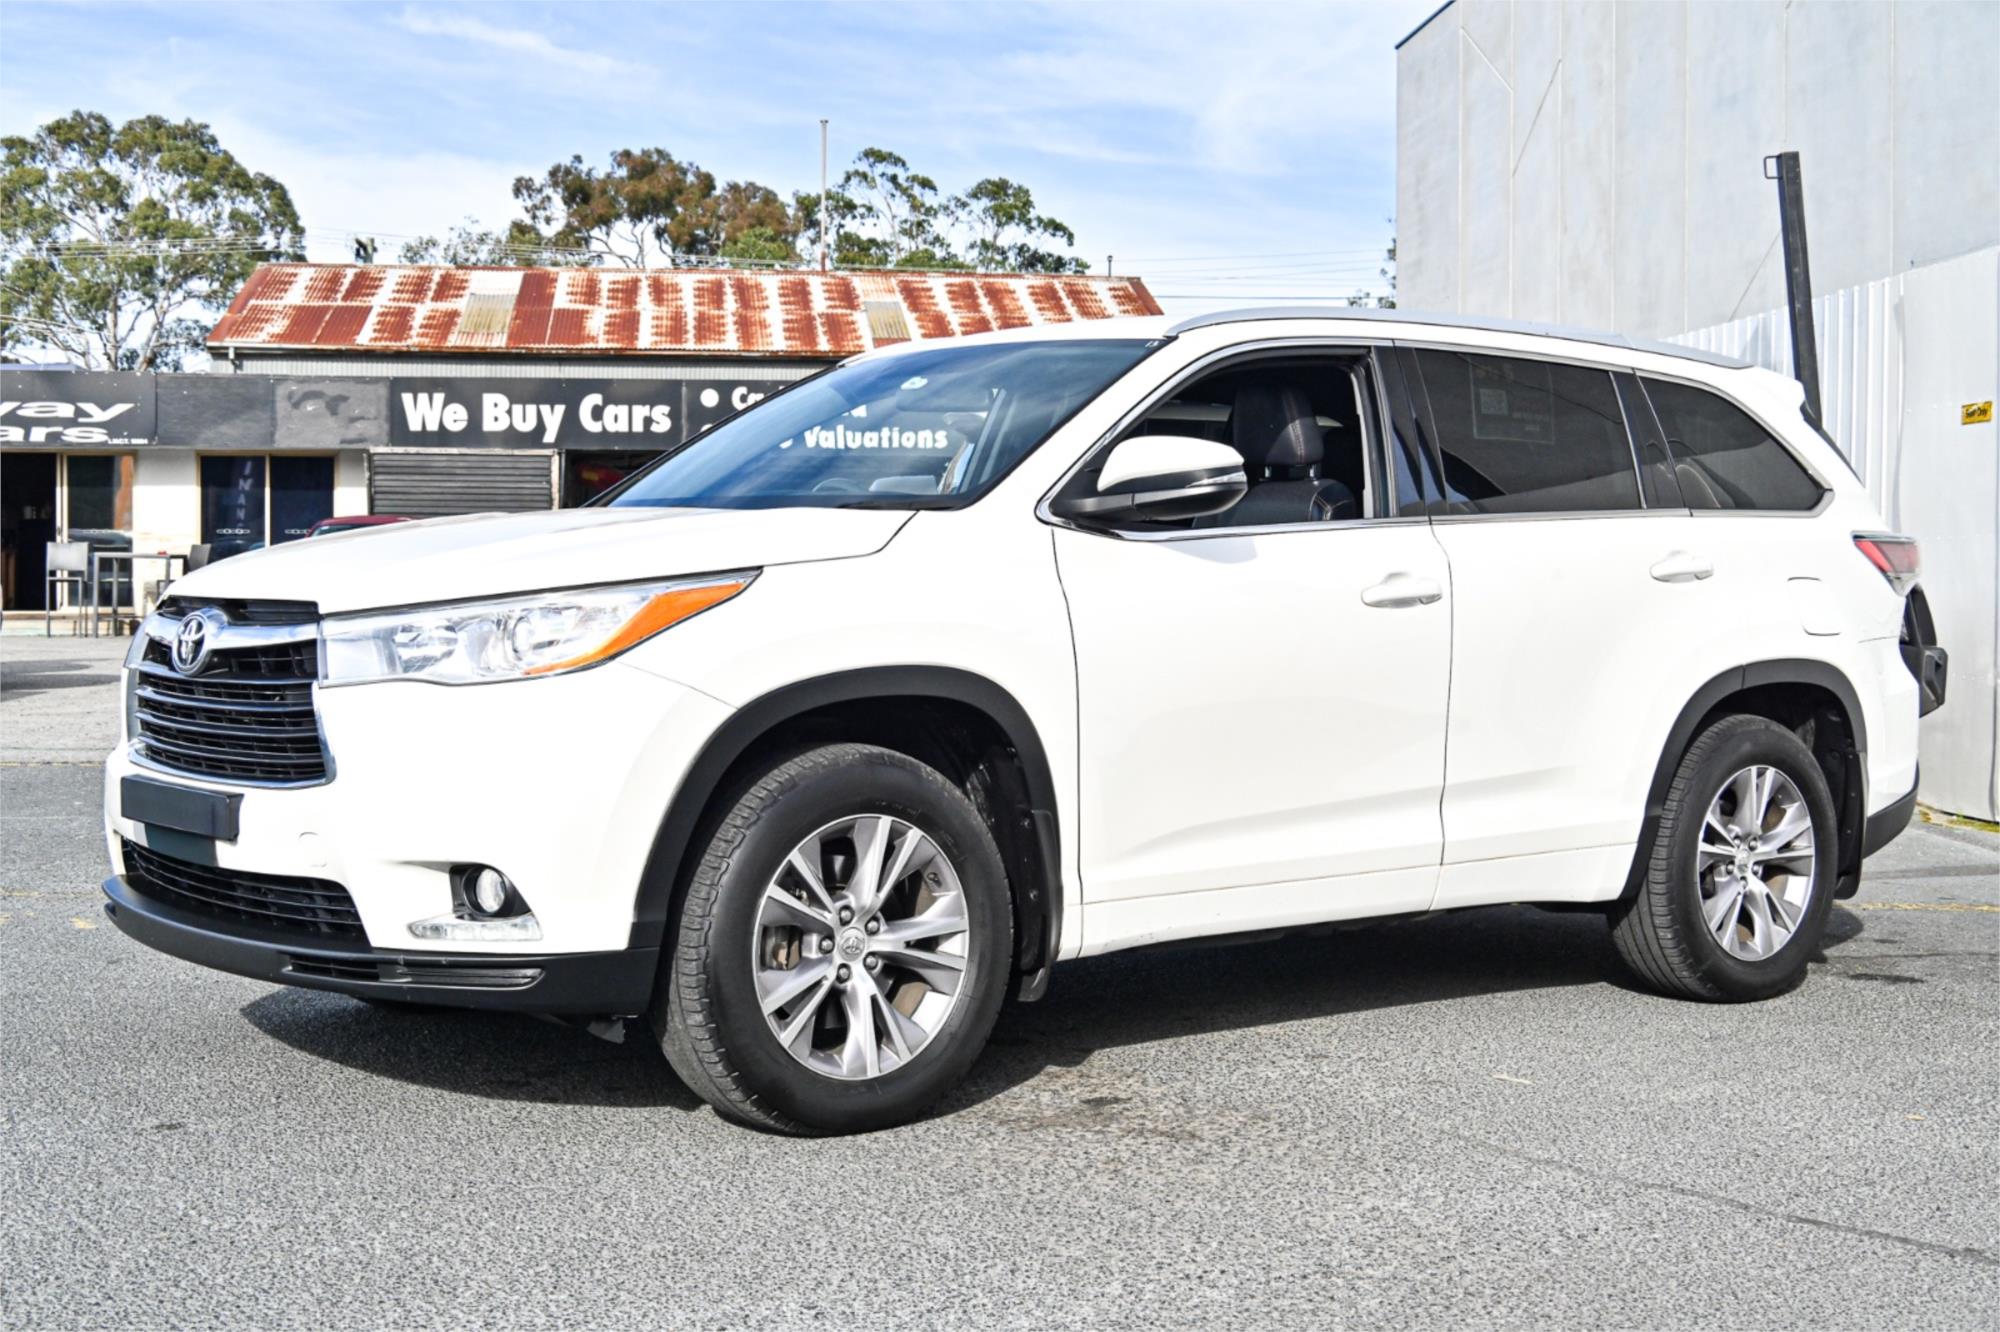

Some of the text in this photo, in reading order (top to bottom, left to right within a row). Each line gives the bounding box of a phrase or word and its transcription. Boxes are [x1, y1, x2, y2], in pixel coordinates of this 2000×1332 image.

[401, 392, 672, 443] We Buy Cars
[804, 424, 949, 450] Valuations
